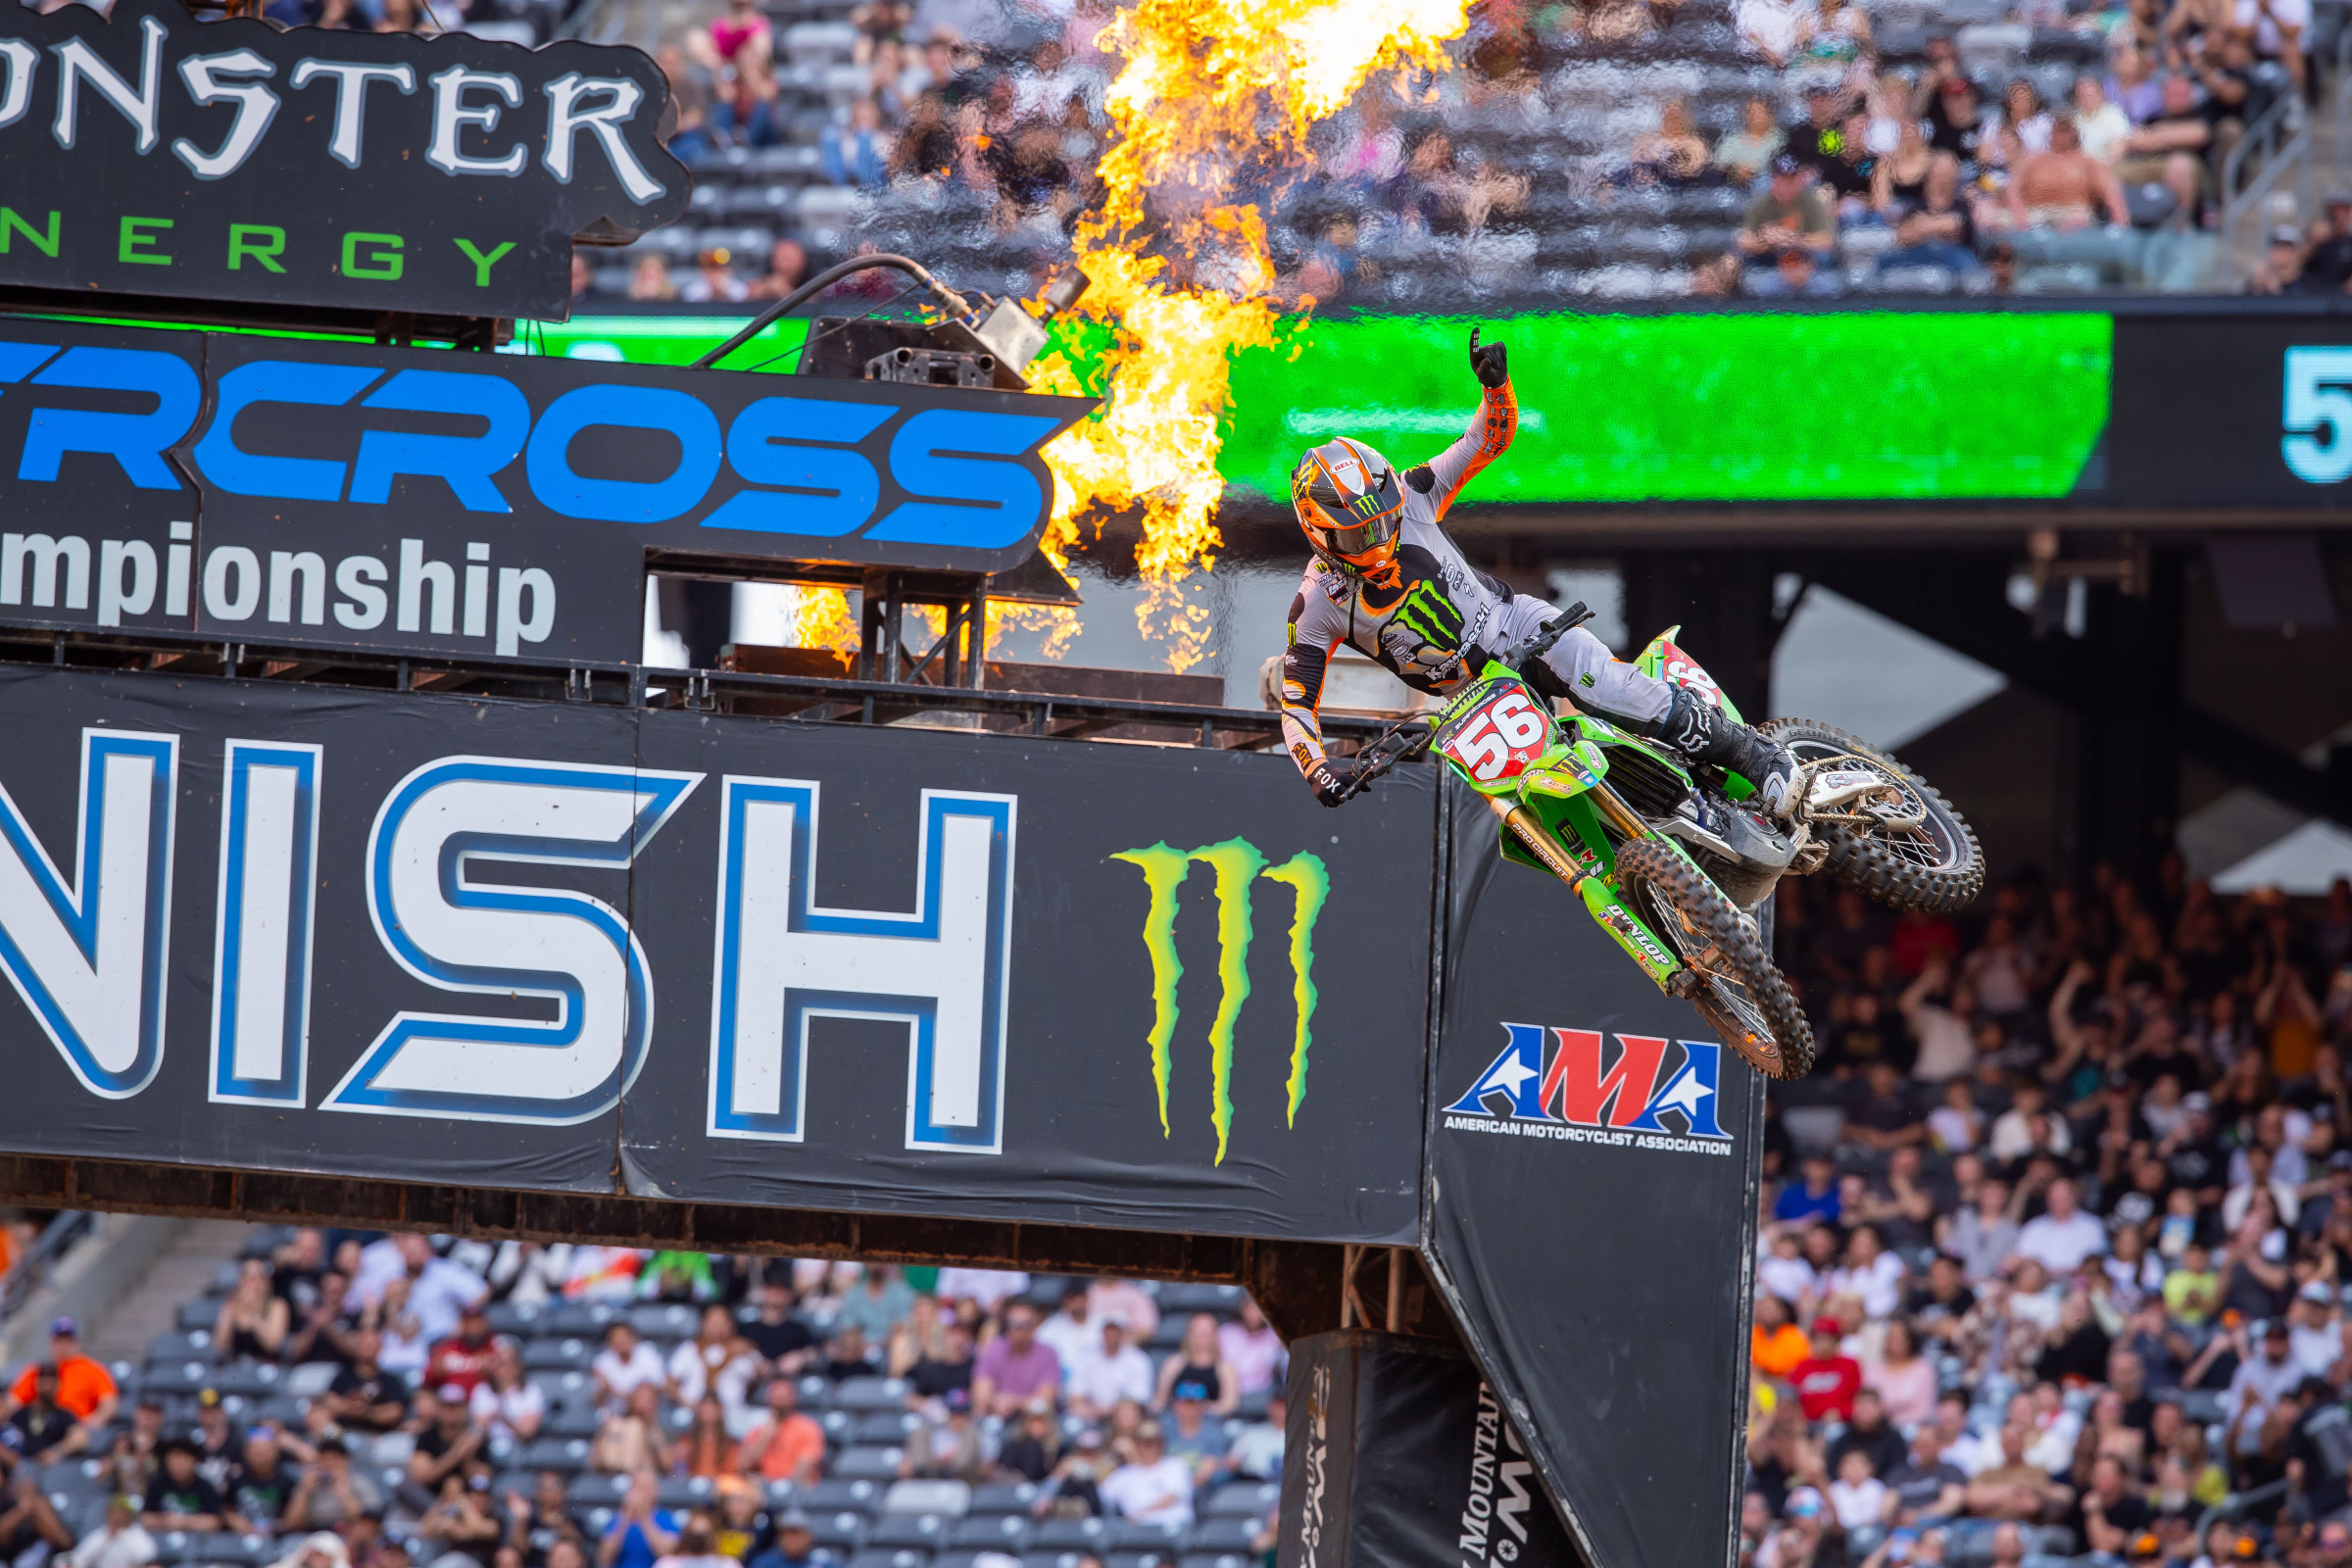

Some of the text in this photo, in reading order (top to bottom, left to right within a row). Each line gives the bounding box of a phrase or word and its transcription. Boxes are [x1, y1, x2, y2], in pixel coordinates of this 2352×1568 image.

[0, 207, 516, 287] NERGY
[2280, 345, 2352, 483] 5
[1334, 460, 1355, 471] BELL
[0, 520, 557, 657] mpionship
[1426, 602, 1489, 680] Kawasaki
[1453, 693, 1544, 781] 56
[1315, 767, 1341, 794] FOX
[1512, 822, 1534, 844] PRO
[1533, 841, 1569, 877] CIRCUIT
[0, 727, 1018, 1154] NISH
[1441, 1021, 1735, 1140] AMA
[1445, 1115, 1732, 1156] AMERICAN MOTORCYCLIST ASSOCIATION
[1458, 1382, 1500, 1560] MOUNTAI
